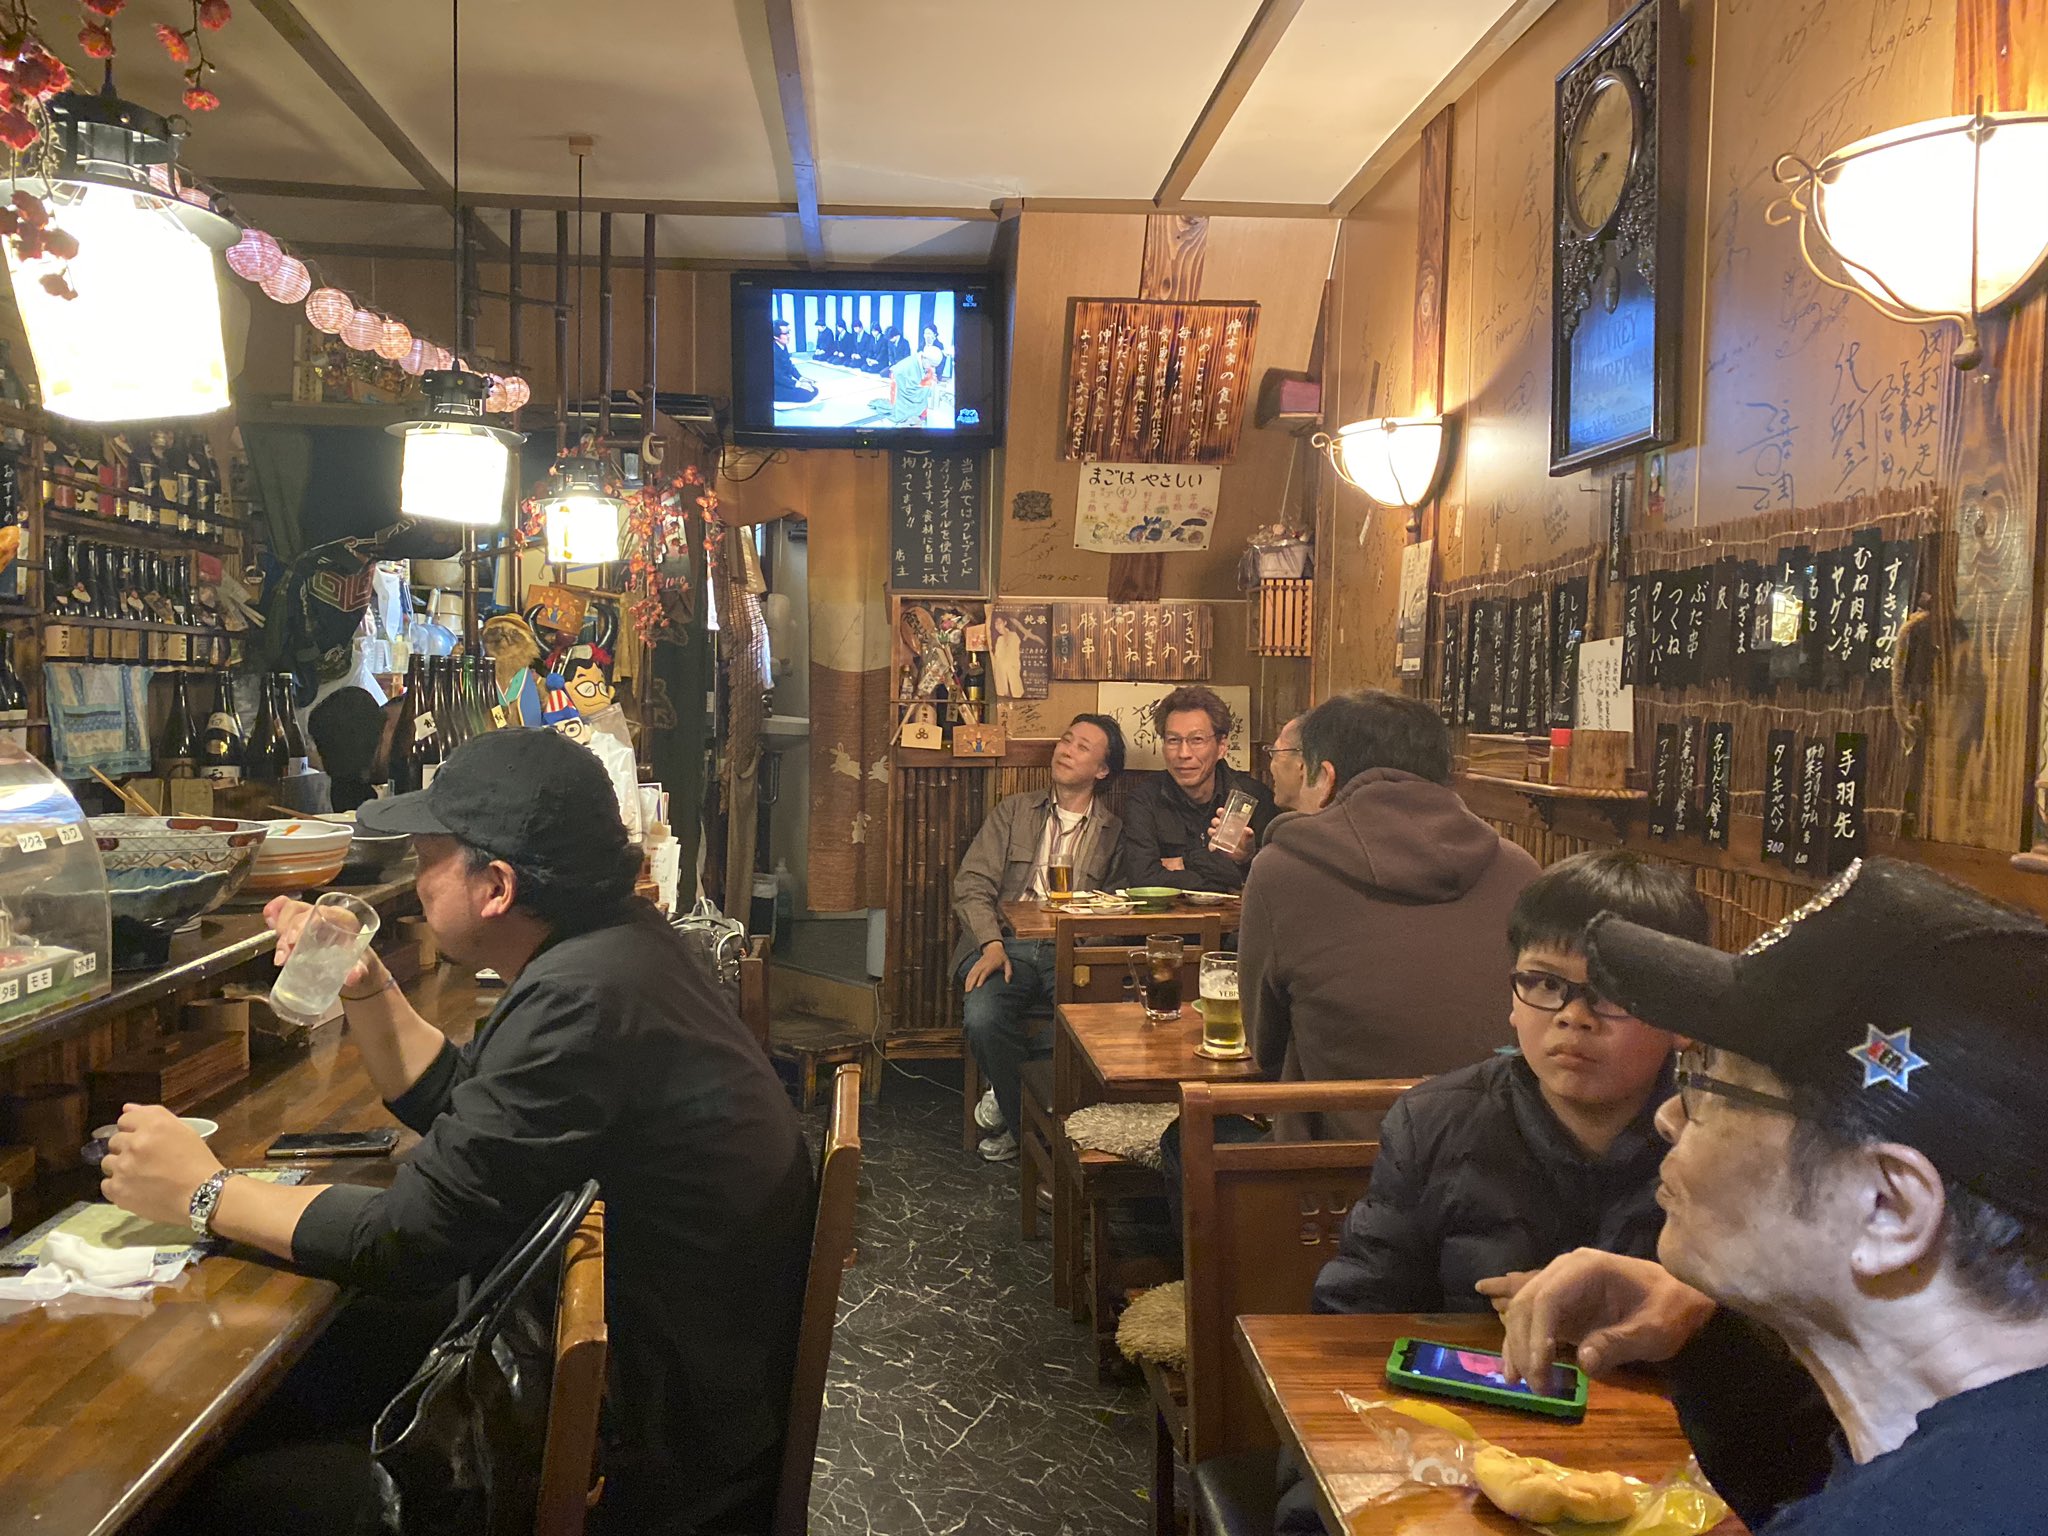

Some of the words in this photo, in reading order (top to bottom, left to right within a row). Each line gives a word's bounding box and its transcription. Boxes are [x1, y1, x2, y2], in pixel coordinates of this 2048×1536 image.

[1213, 318, 1242, 431] 仲本家の食卓
[1089, 467, 1135, 485] まごは
[1140, 472, 1203, 488] やさしい
[895, 548, 909, 577] 店主
[1077, 612, 1097, 660] 豚串
[1123, 610, 1141, 662] つくね
[1161, 609, 1178, 658] かわ
[1625, 584, 1640, 678] ゴマ塩レバー
[1649, 581, 1663, 676] タレレバー
[1667, 588, 1683, 655] つくね
[1687, 580, 1710, 660] ぶた串
[1737, 578, 1750, 655] ねぎま
[1754, 580, 1774, 642] 砂肝
[1808, 576, 1819, 632] もも
[1876, 557, 1903, 653] すきみ
[1142, 612, 1160, 667] ねぎま
[1182, 608, 1202, 665] すきみ
[1510, 605, 1522, 705] オリジナルカレー
[1654, 738, 1669, 806] アジフライ
[1770, 744, 1786, 833] タレキャベツ
[1833, 748, 1856, 838] 手羽先
[20, 835, 44, 849] ツクネ
[30, 973, 49, 988] モモ
